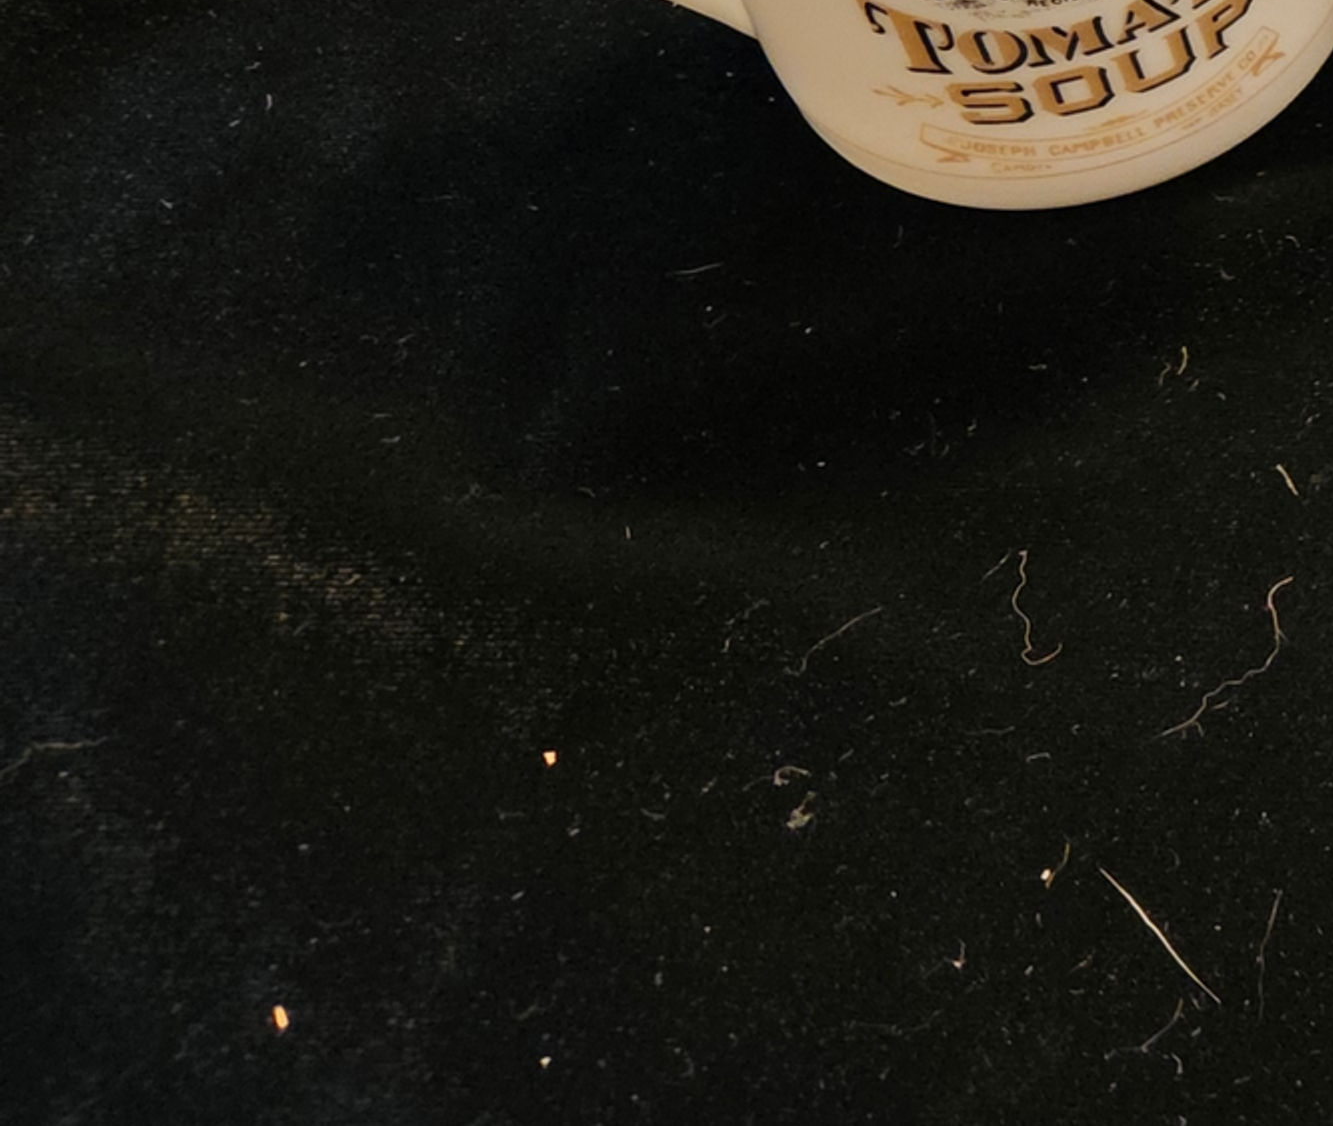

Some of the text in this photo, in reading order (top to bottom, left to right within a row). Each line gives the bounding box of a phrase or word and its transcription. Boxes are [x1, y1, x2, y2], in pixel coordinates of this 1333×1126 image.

[960, 138, 1037, 157] JOSEPH
[1049, 127, 1144, 157] CAMPBELL
[1154, 71, 1236, 127] PRESERVE
